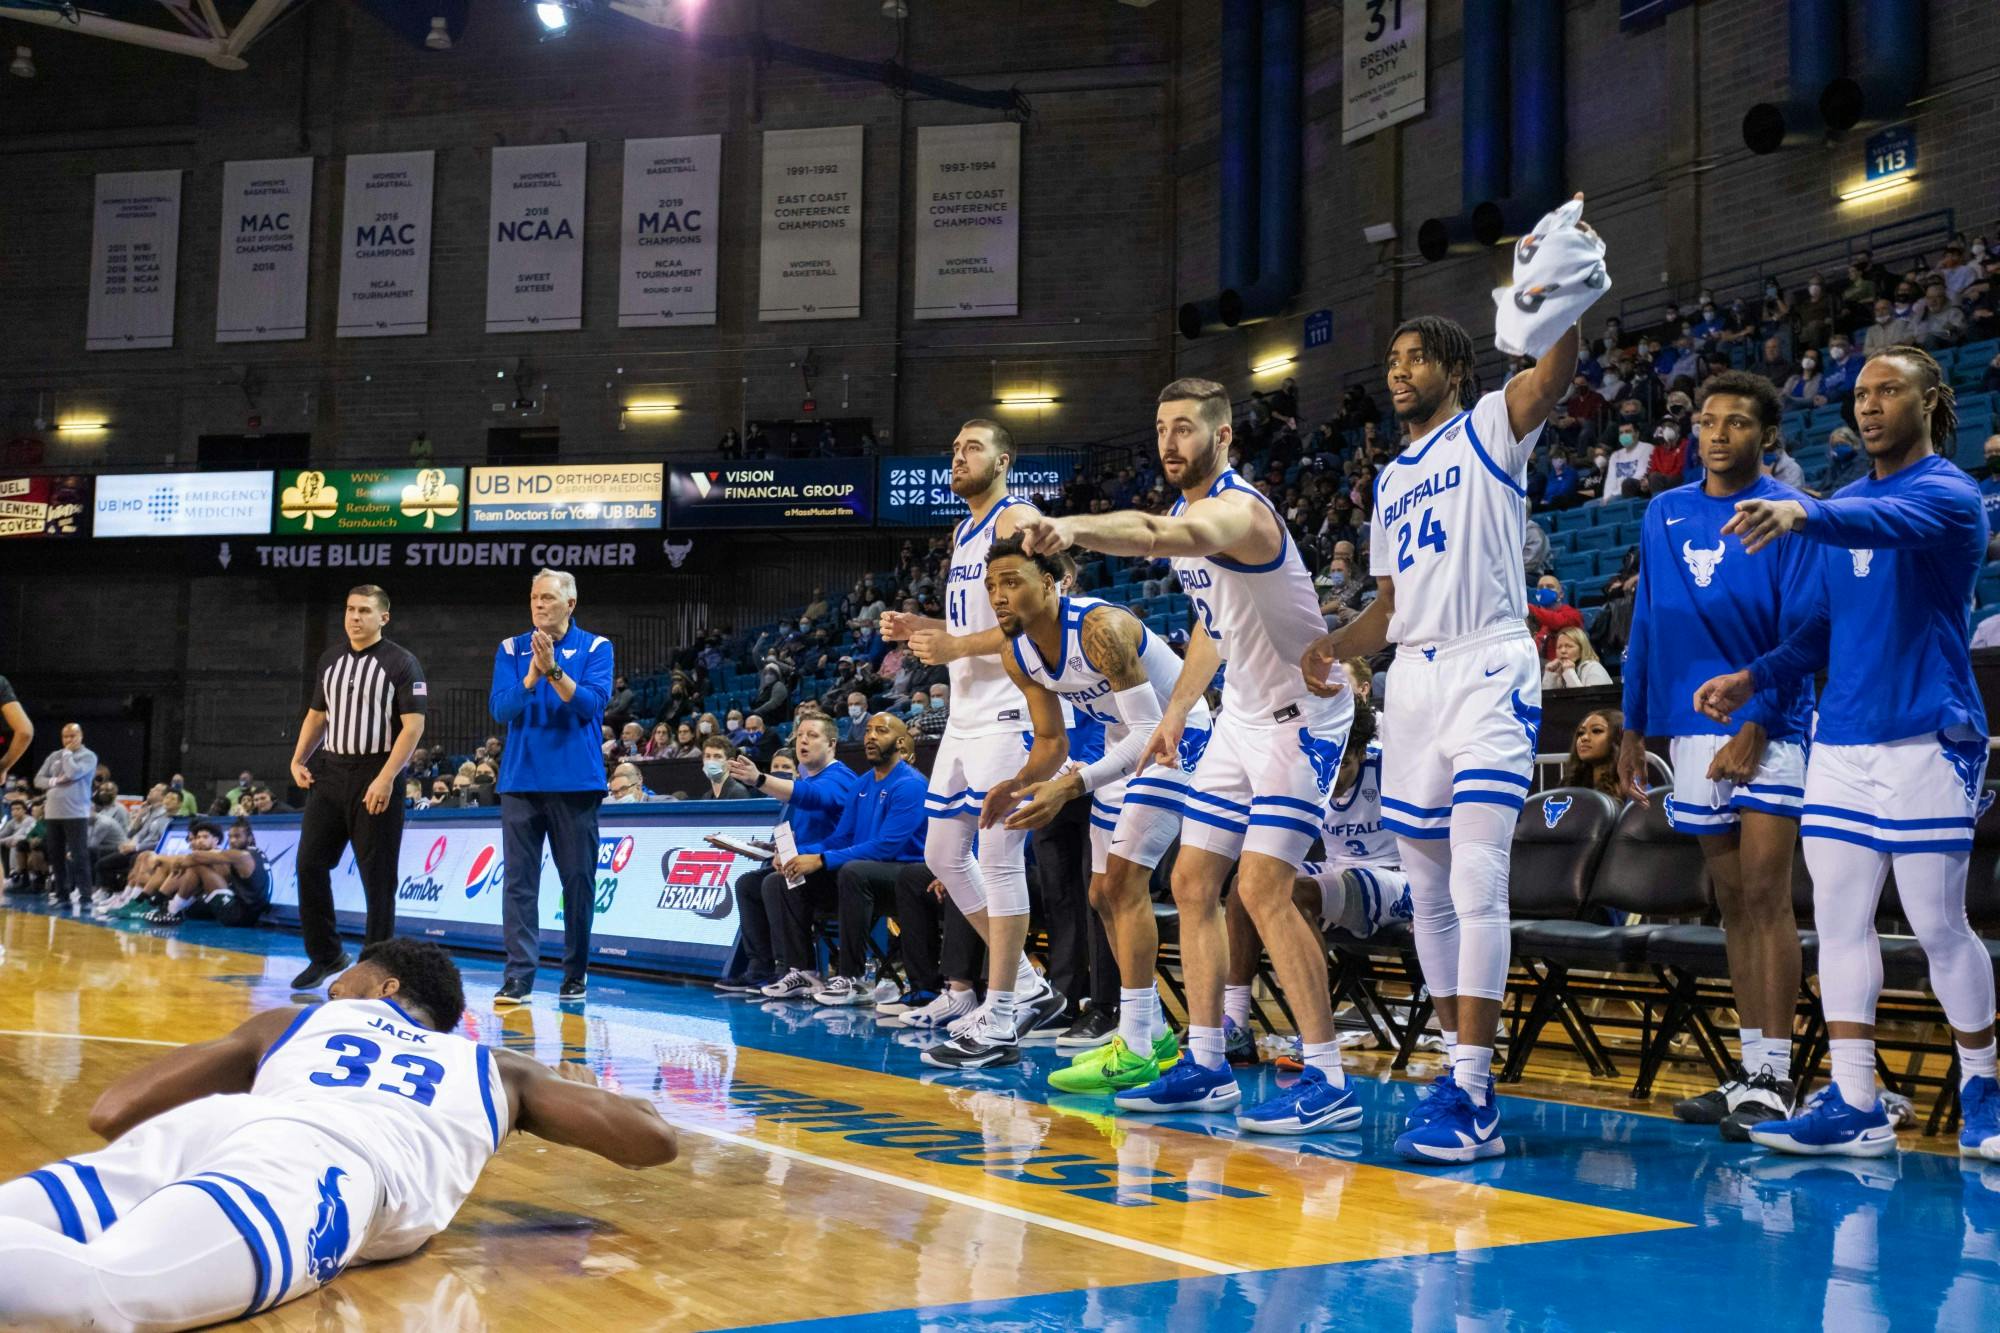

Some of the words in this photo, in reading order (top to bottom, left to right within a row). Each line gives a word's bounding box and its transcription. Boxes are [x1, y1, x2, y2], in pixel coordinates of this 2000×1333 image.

[1360, 39, 1407, 69] BRENNA
[1367, 56, 1399, 80] DOTY
[653, 157, 691, 166] WOMEN'S
[940, 162, 997, 173] 1993-1994
[1875, 149, 1906, 174] 113
[646, 165, 697, 175] BASKETBALL
[786, 165, 838, 176] 1991-1992
[778, 195, 807, 205] EAST
[809, 192, 848, 203] COAST
[932, 192, 962, 202] EAST
[965, 189, 1005, 200] COAST
[659, 199, 683, 208] 2019
[929, 202, 1008, 215] CONFERENCE
[774, 205, 850, 218] CONFERENCE
[241, 213, 290, 232] MAC
[638, 210, 702, 234] MAC
[778, 219, 846, 231] CHAMPIONS
[933, 216, 1003, 228] CHAMPIONS
[356, 224, 416, 247] MAC
[498, 218, 574, 242] NCAA
[638, 235, 702, 247] CHAMPIONS
[236, 243, 293, 254] CHAMPIONS
[355, 249, 415, 259] CHAMPIONS
[133, 263, 160, 272] NCAA
[655, 260, 682, 268] NCAA
[790, 260, 831, 269] WOMEN'S
[945, 258, 988, 268] WOMEN'S
[518, 273, 550, 282] SWEET
[635, 269, 702, 280] TOURNAMENT
[782, 269, 837, 279] BASKETBALL
[938, 267, 994, 276] BASKETBALL
[133, 274, 160, 283] NCAA
[132, 285, 159, 294] NCAA
[370, 281, 396, 290] NCAA
[514, 284, 554, 294] SIXTEEN
[352, 290, 414, 301] TOURNAMENT
[1310, 327, 1328, 344] 111
[555, 472, 661, 485] ORTHOPAEDICS
[726, 470, 775, 482] VISION
[476, 475, 510, 494] UB
[517, 475, 553, 493] MD
[184, 489, 268, 502] EMERGENCY
[725, 485, 799, 499] FINANCIAL
[803, 484, 855, 497] GROUP
[1384, 465, 1461, 530] BUFFALO
[184, 506, 255, 518] MEDICINE
[346, 503, 391, 513] Reuben
[474, 509, 503, 521] Team
[505, 508, 548, 521] Doctors
[550, 508, 568, 520] for
[602, 504, 624, 519] UB
[625, 503, 657, 519] Bulls
[838, 508, 854, 516] firm
[337, 518, 397, 528] Sandwich
[1397, 507, 1447, 573] 24
[256, 545, 322, 567] TRUE
[327, 543, 391, 567] BLUE
[405, 543, 526, 566] STUDENT
[531, 543, 637, 566] CORNER
[950, 589, 967, 627] 41
[1345, 839, 1370, 856] 3
[667, 850, 736, 887] ESPN
[399, 875, 444, 902] ComDoc
[659, 886, 721, 912] 1520AM
[367, 1018, 428, 1044] JACK
[309, 1034, 446, 1108] 33
